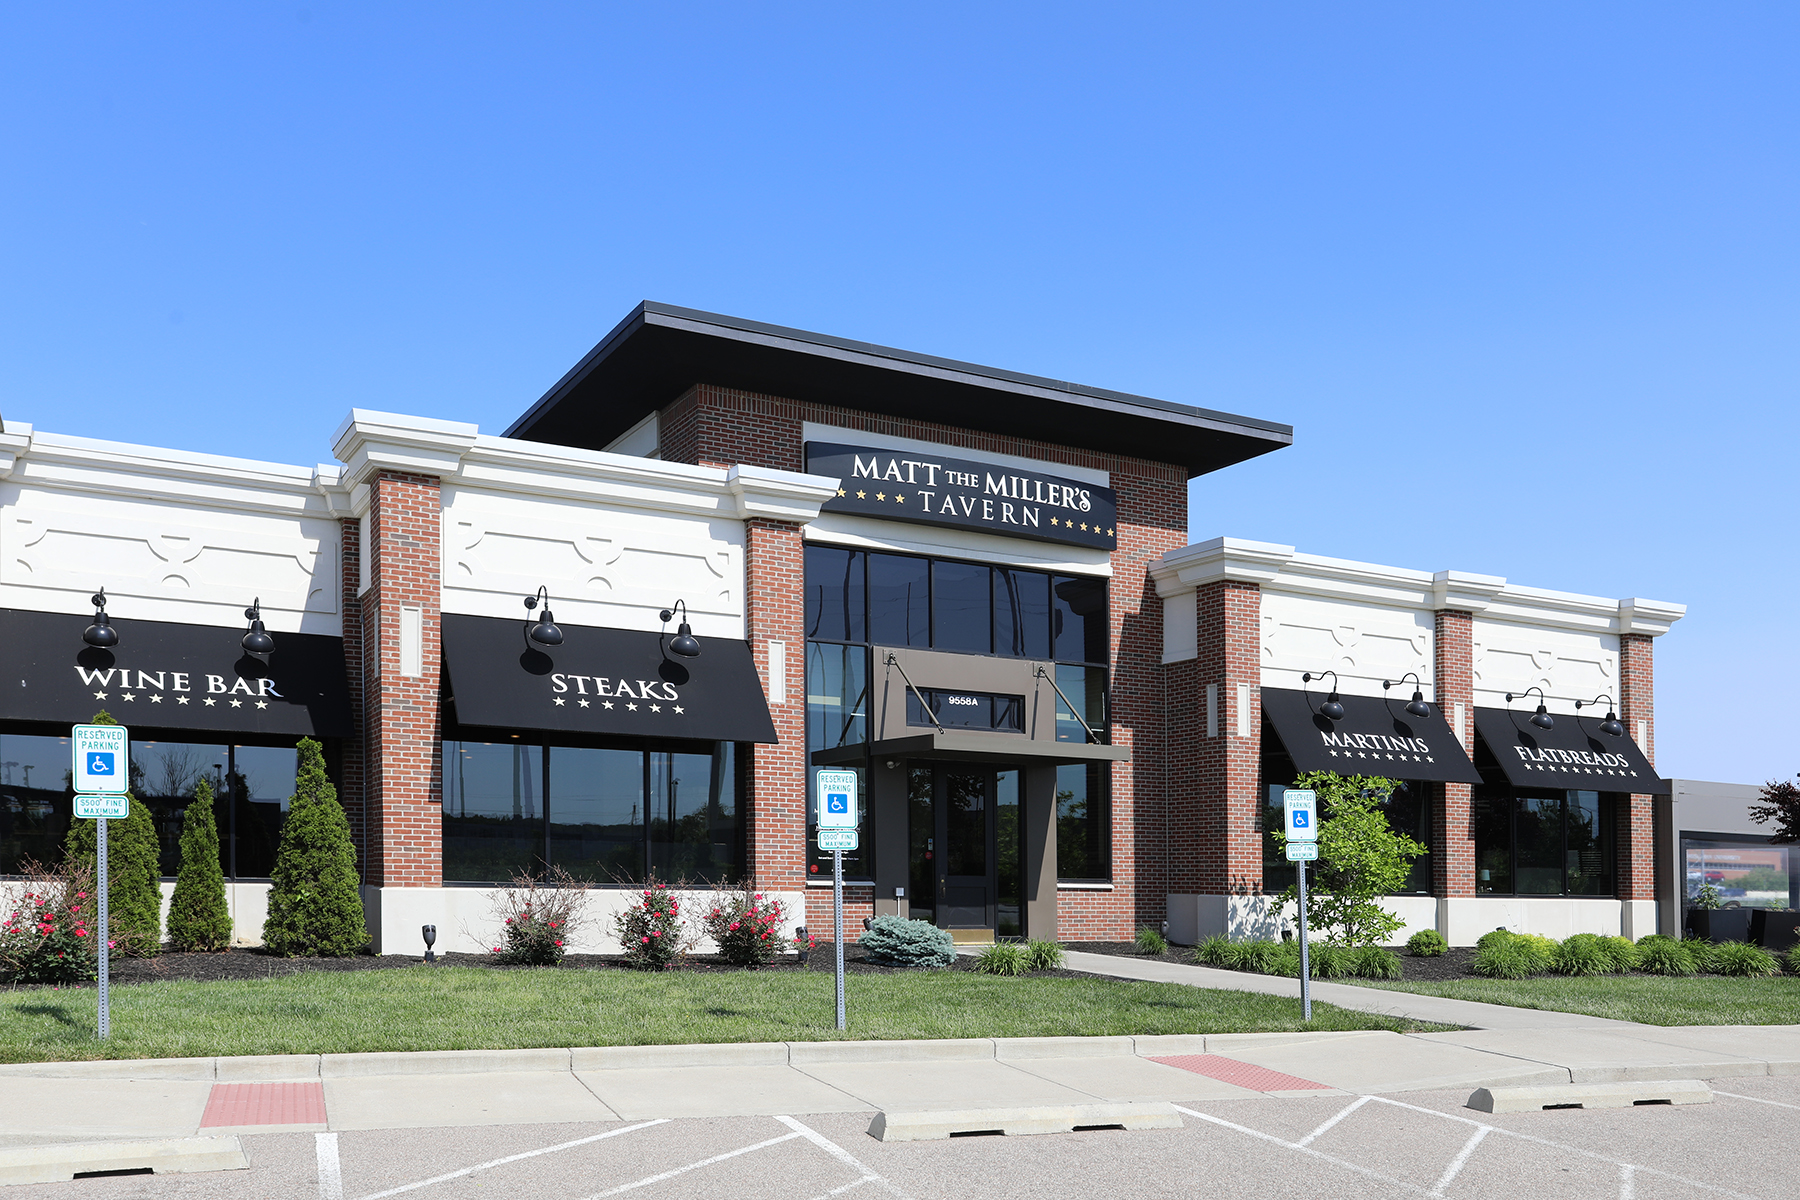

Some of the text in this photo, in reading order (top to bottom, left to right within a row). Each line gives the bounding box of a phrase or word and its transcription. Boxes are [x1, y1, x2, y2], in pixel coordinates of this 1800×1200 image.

[851, 454, 1092, 513] MATT THE MILLER'S
[917, 490, 1040, 528] TAVERN
[73, 665, 284, 698] WINE BAR
[551, 673, 679, 701] STEAKS
[948, 695, 979, 706] 9558A
[77, 730, 123, 740] RESERVED
[81, 741, 120, 750] PARKING
[1320, 730, 1430, 753] MARTINIS
[1513, 745, 1629, 768] FLATBREADS
[820, 775, 853, 783] RESERVED
[823, 784, 851, 792] PARKING
